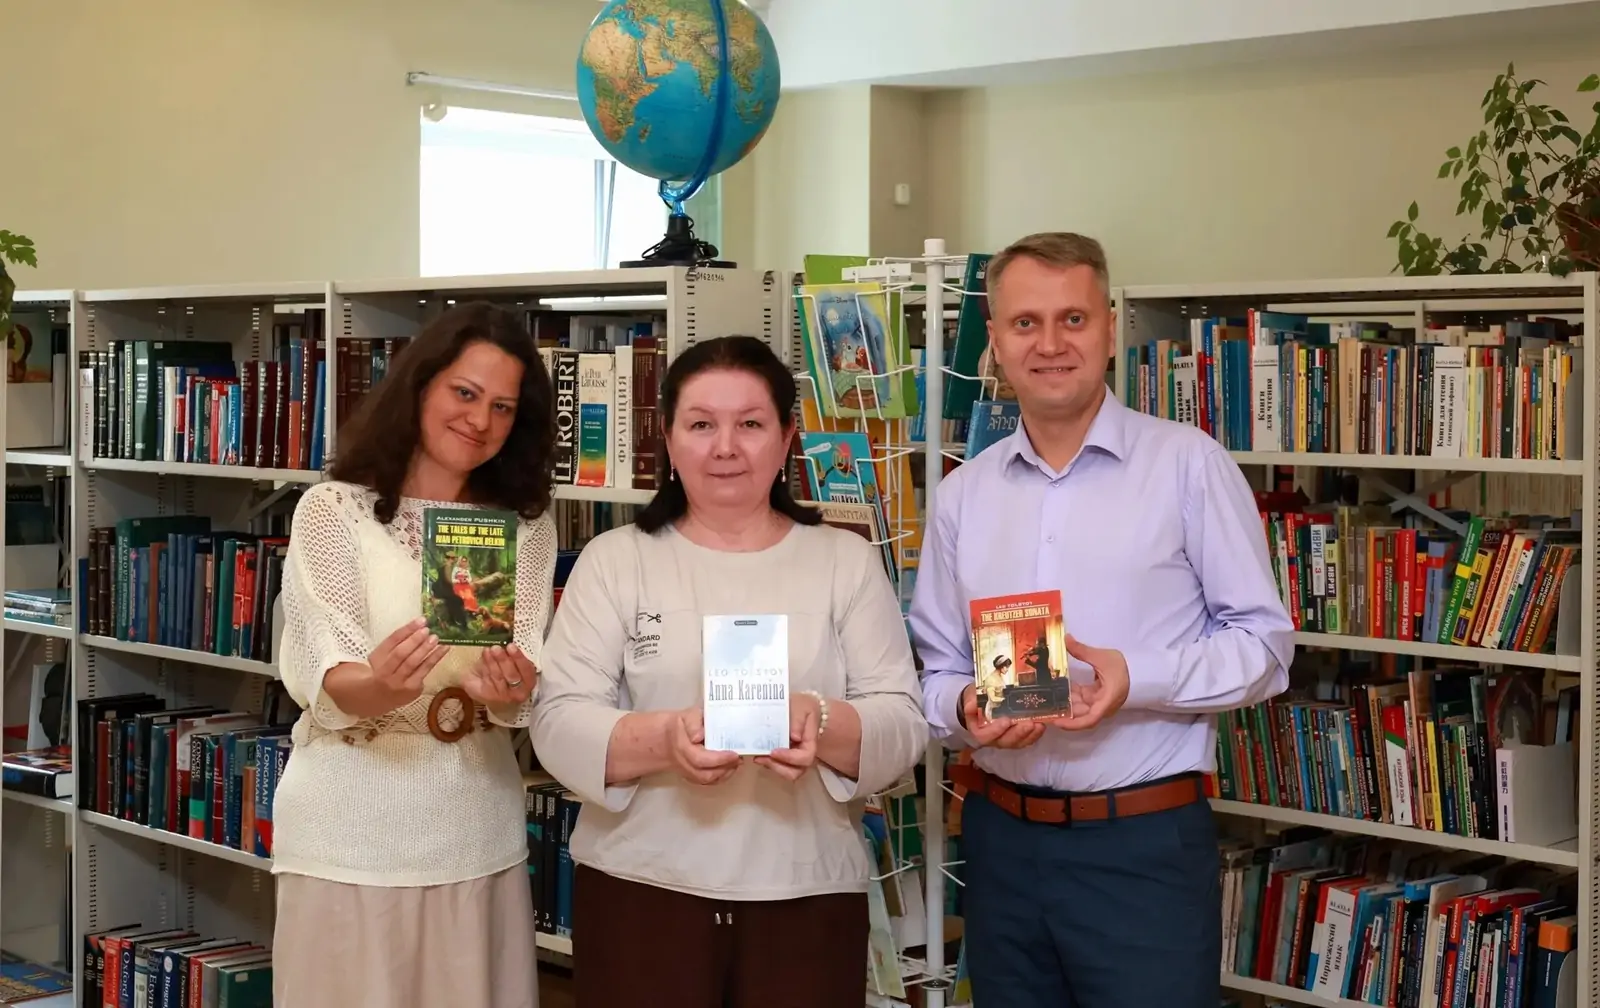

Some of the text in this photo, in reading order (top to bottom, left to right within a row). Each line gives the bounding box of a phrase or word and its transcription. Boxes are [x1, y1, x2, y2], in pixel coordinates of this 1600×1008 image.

[556, 354, 575, 447] ROBERT
[618, 376, 627, 463] ФРАНЦИЯ
[436, 535, 505, 546] IVAN PETROVICH BELKIN
[438, 525, 450, 533] THE
[451, 525, 468, 534] TALES
[478, 527, 488, 535] THE
[489, 528, 504, 536] LATE
[1312, 530, 1322, 559] ИВРИТ
[1328, 566, 1336, 595] ИВРИТ
[981, 606, 1050, 621] THE KREUTZER SONATA
[1440, 579, 1461, 639] ESPAÑOL EN VIVO
[708, 668, 728, 676] LEO
[709, 679, 785, 701] Anna Karenina
[262, 746, 272, 804] LONGMAN
[1319, 923, 1336, 986] Норвежский
[1335, 945, 1343, 971] язык
[122, 952, 130, 997] Oxford
